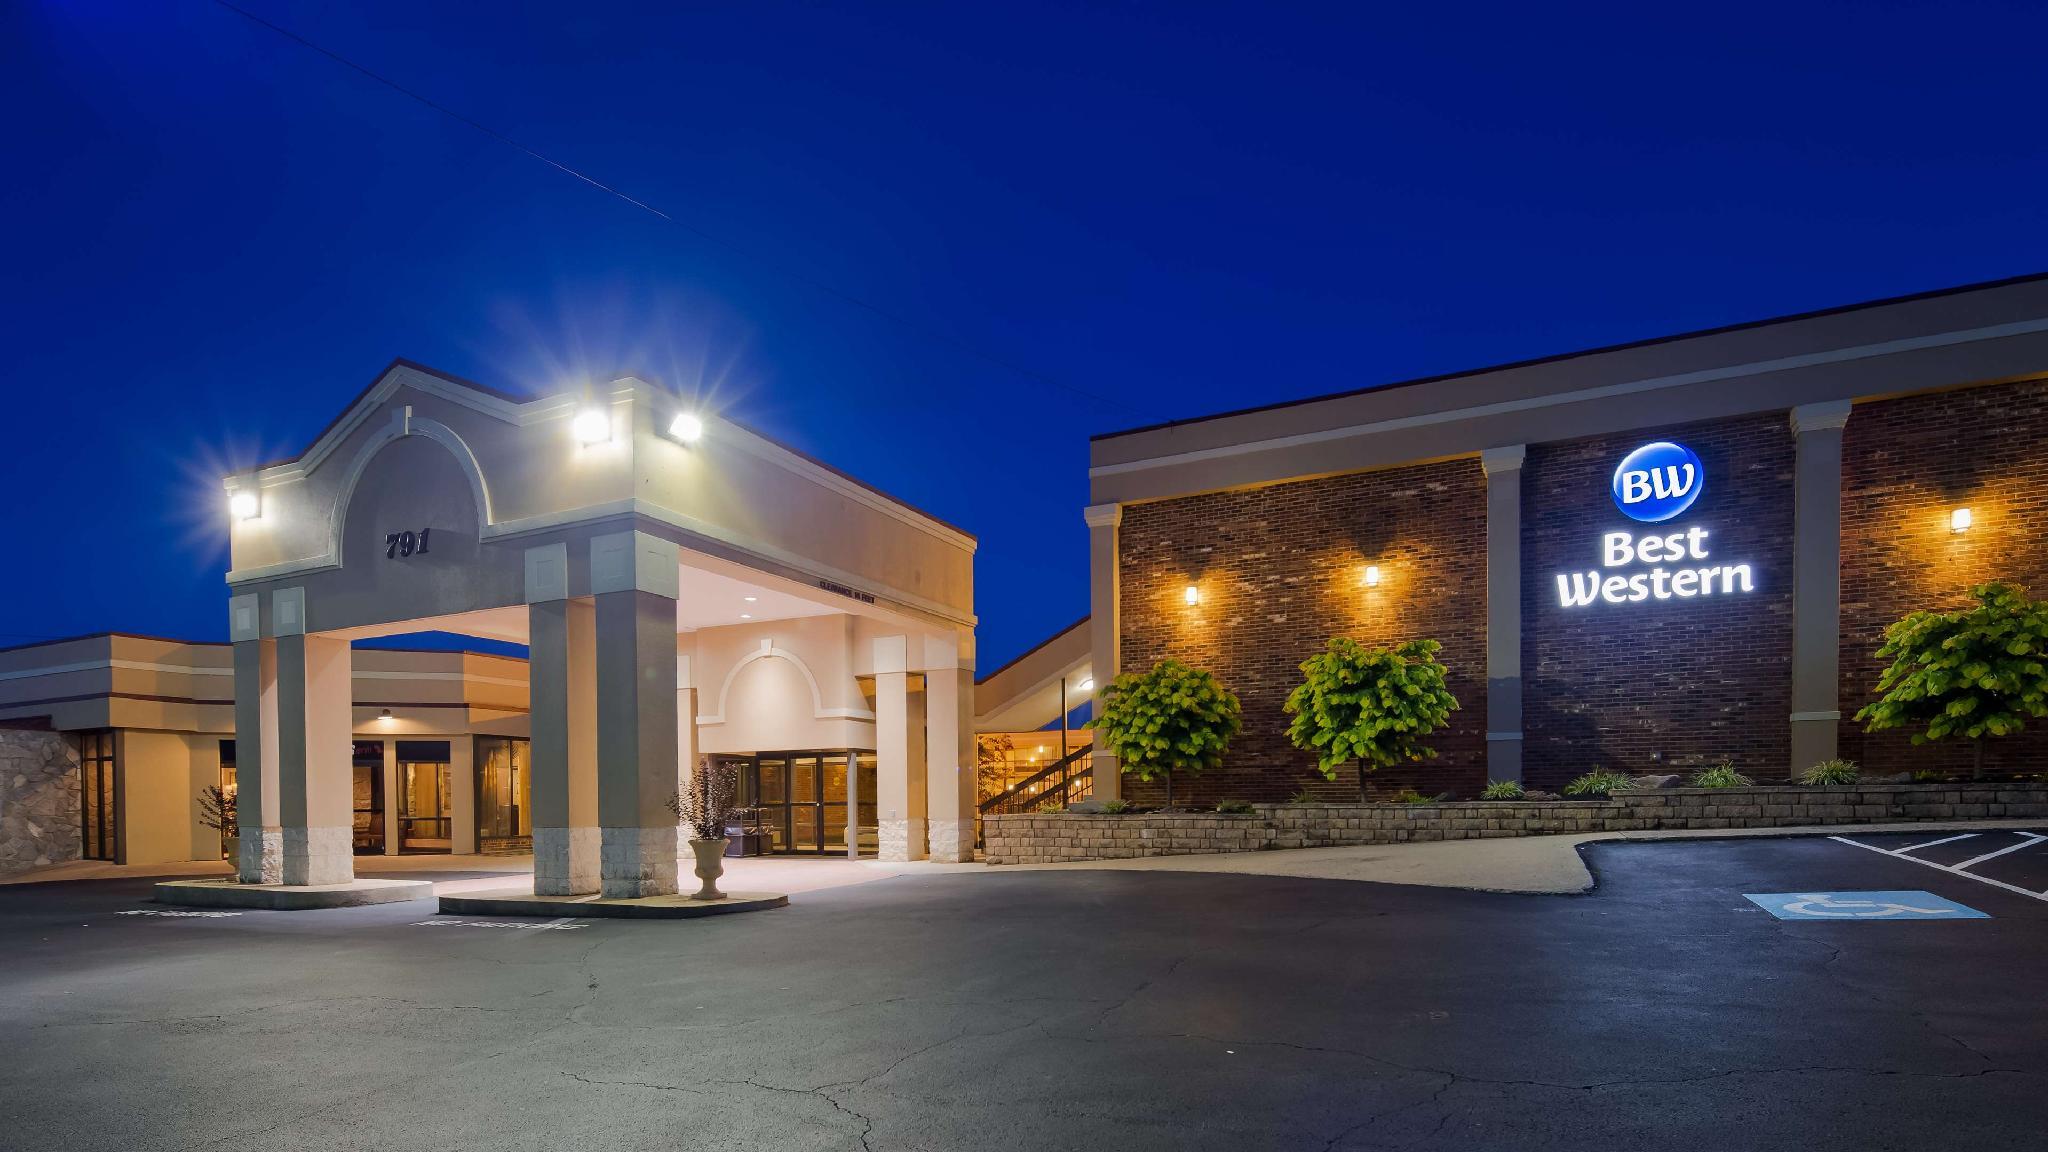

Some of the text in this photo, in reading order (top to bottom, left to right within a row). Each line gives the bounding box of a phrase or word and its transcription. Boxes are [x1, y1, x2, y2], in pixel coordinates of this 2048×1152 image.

[1623, 464, 1694, 504] BW
[385, 528, 430, 559] 791
[1604, 527, 1709, 566] Best
[1556, 564, 1754, 607] Western
